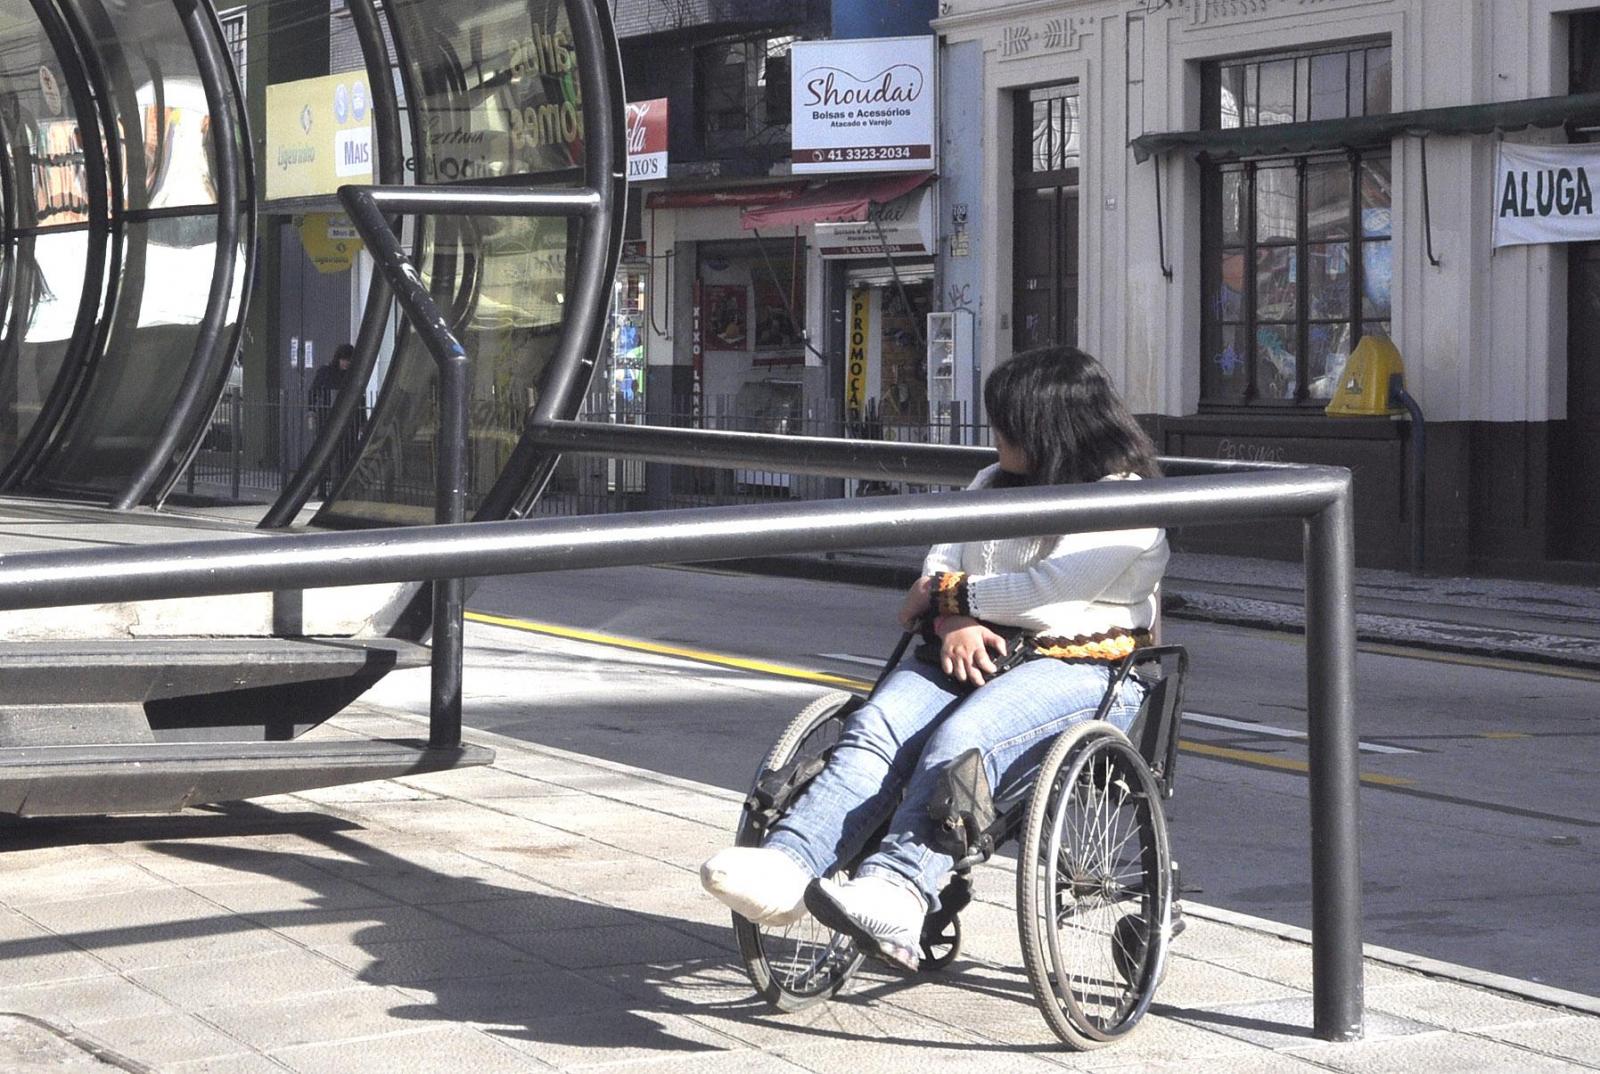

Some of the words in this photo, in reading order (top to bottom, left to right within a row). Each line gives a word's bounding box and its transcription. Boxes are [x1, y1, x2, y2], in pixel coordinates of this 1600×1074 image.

[803, 71, 918, 106] Shoudai
[812, 110, 845, 120] Bolsas
[856, 108, 911, 118] Acessórios
[830, 120, 860, 128] Atacado
[869, 119, 892, 127] Varejo
[827, 150, 843, 160] 41
[846, 147, 911, 160] 3323-2034
[630, 158, 659, 176] IXO'S
[1500, 167, 1593, 217] ALUGA
